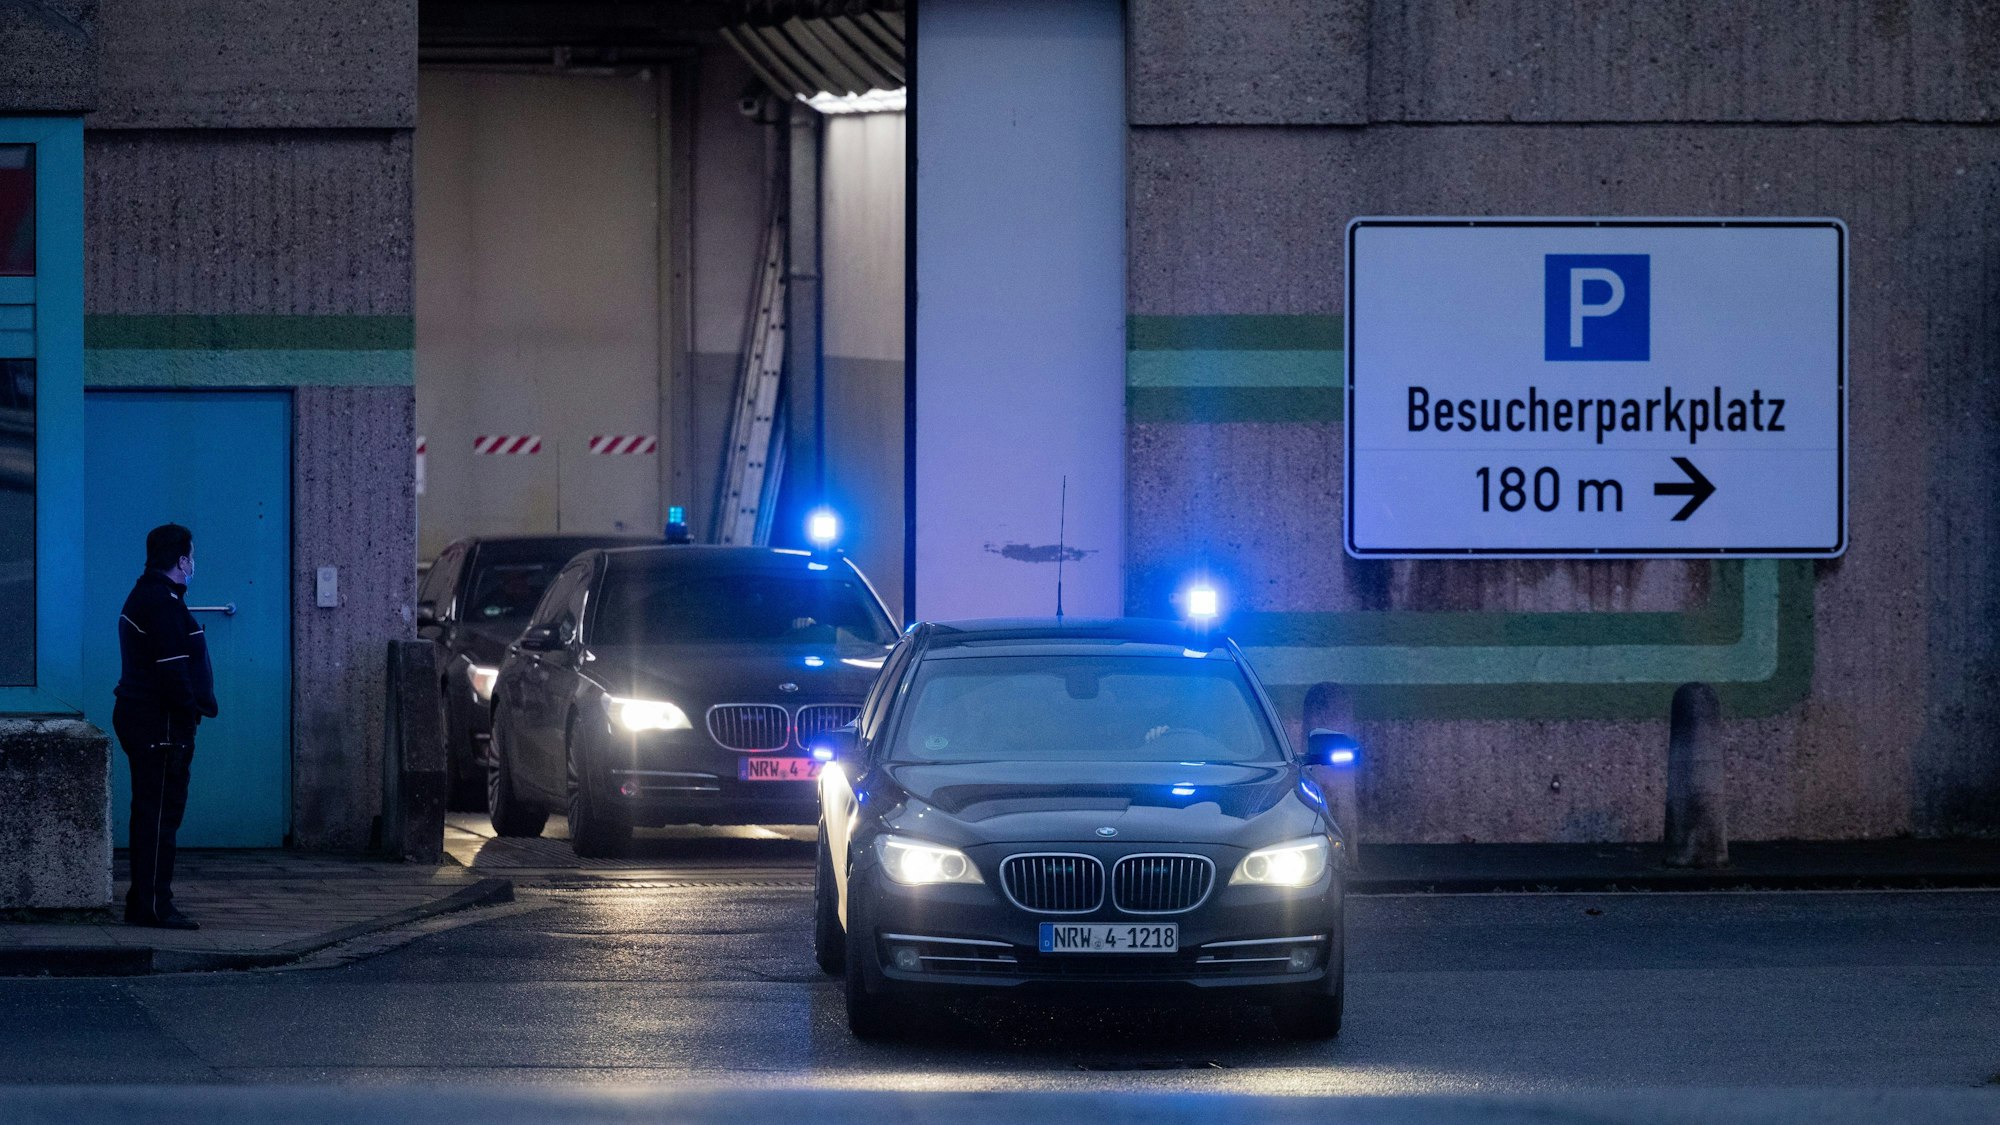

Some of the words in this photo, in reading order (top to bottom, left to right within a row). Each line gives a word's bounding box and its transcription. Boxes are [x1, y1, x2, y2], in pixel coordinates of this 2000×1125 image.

[1570, 268, 1625, 348] P
[1407, 386, 1786, 444] Besucherparkplatz
[1476, 466, 1560, 512] 180
[1578, 478, 1623, 512] m
[749, 760, 779, 777] NRW
[789, 760, 818, 777] 4-2
[1054, 927, 1091, 948] NRW
[1105, 927, 1175, 948] 4-1218
